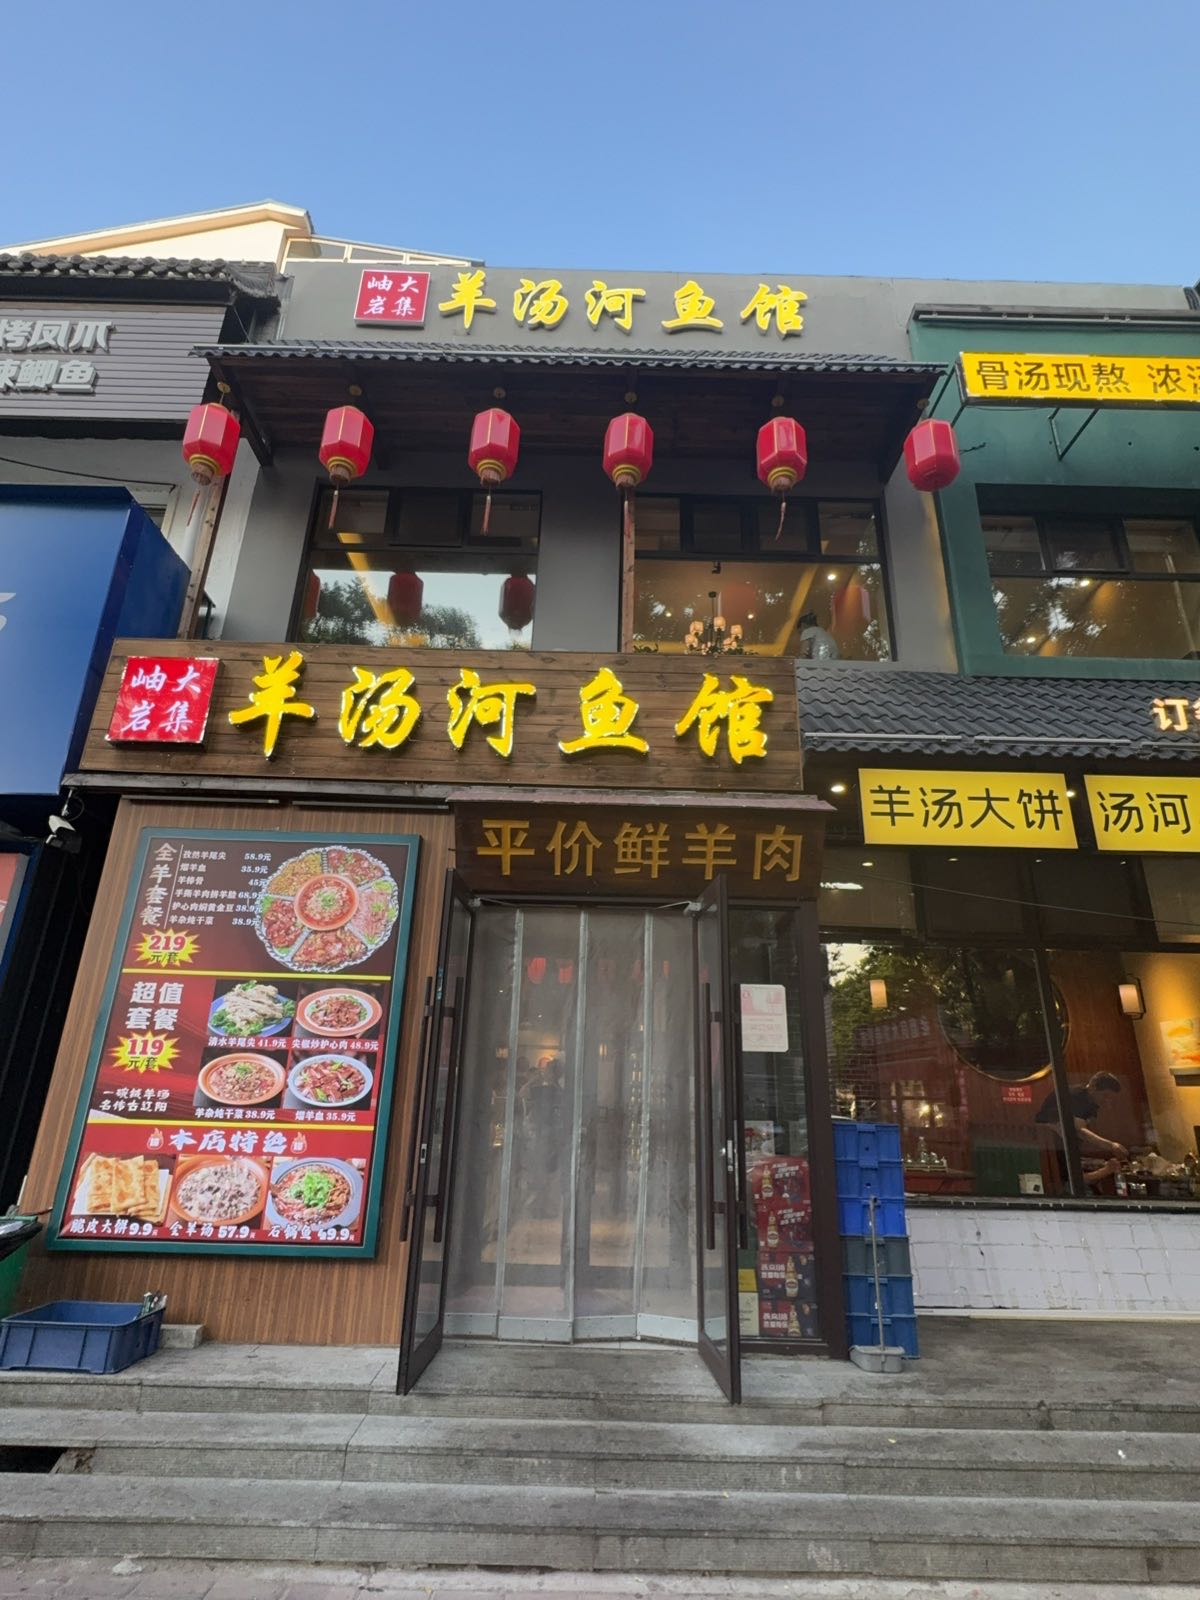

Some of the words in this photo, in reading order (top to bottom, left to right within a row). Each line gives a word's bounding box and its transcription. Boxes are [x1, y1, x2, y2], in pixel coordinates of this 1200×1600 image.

[438, 269, 808, 335] 羊汤河鱼馆
[976, 360, 1131, 393] 骨汤现熬
[1146, 363, 1200, 394] 浓
[227, 650, 773, 764] 羊汤河鱼馆
[870, 785, 1063, 831] 羊汤大饼
[1097, 791, 1191, 834] 汤河
[244, 852, 272, 862] 58.9元
[476, 819, 803, 882] 平价鲜羊肉
[240, 865, 268, 874] 35.9元
[140, 842, 178, 927] 全羊套餐
[148, 934, 187, 950] 219
[150, 951, 179, 963] 元/套
[130, 981, 184, 1004] 超值
[125, 1006, 179, 1031] 套餐
[128, 1038, 165, 1056] 119
[257, 1038, 288, 1049] 41.9元
[350, 1040, 379, 1050] 48.9元
[128, 1057, 158, 1068] 元/套
[245, 1109, 276, 1121] 38.9元
[325, 1111, 356, 1122] 35.9元
[168, 1128, 287, 1155] 本店特色
[69, 1217, 128, 1235] 脆皮大饼
[168, 1220, 213, 1238] 全羊汤
[267, 1224, 312, 1240] 石锅鱼
